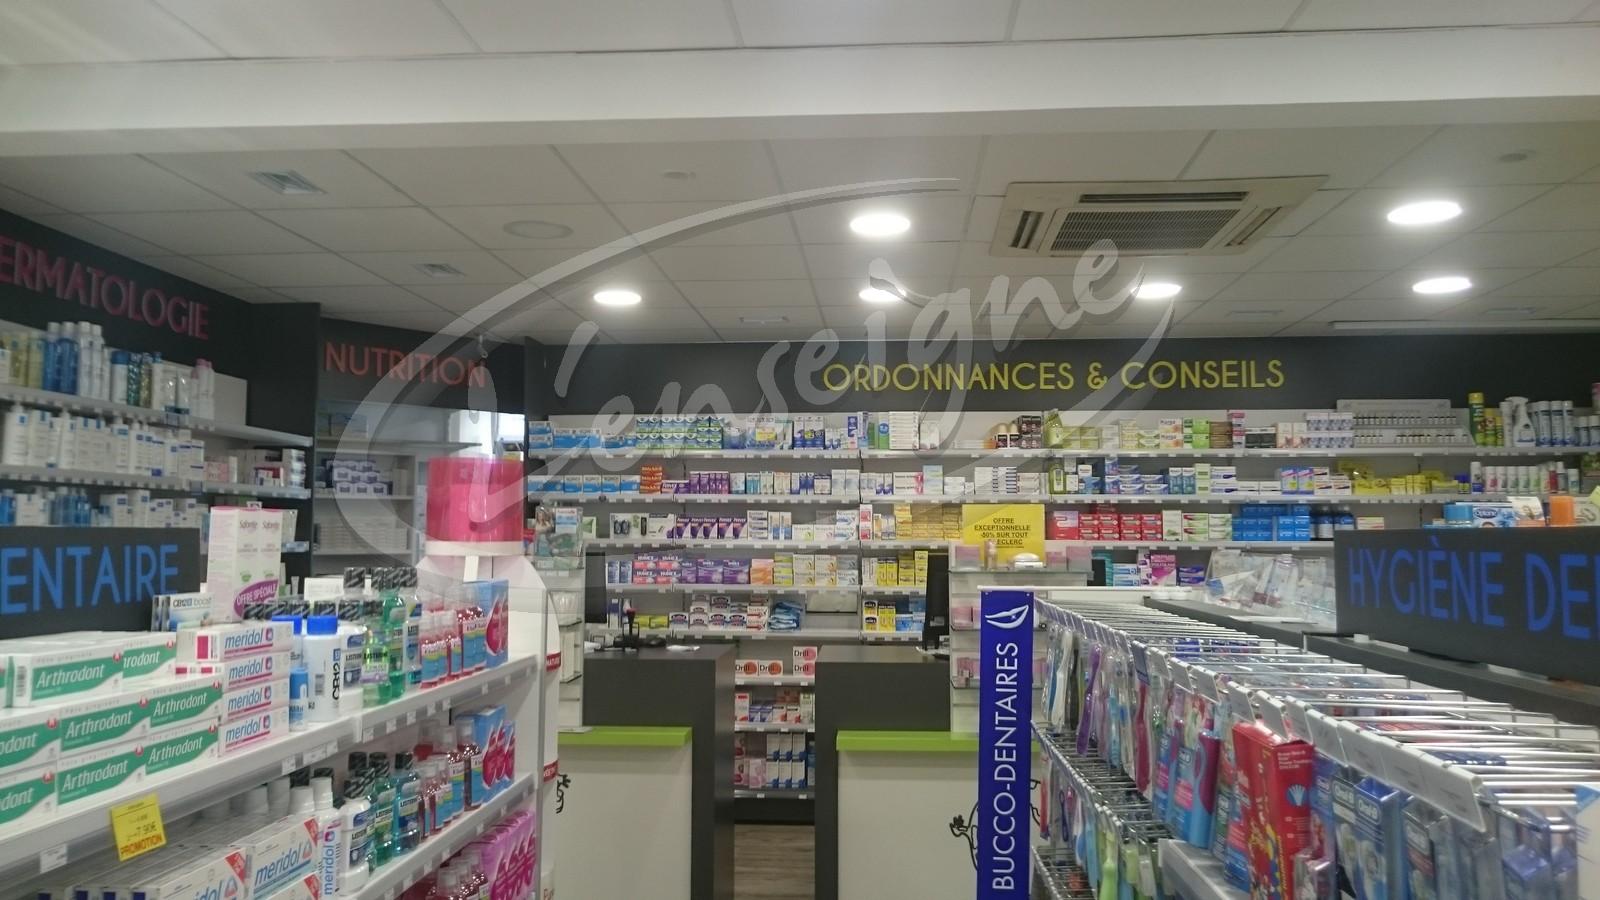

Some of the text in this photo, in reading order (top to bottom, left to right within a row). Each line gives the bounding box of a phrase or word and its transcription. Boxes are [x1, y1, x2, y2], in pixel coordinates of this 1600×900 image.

[325, 342, 486, 388] NUTRITION
[823, 360, 1284, 391] ORDONNANCES & CONSEILS
[1, 544, 178, 615] ENTAIRE
[1347, 535, 1600, 645] HYGIÈNE DE
[225, 627, 263, 650] meridol
[36, 664, 106, 689] Arthrodont
[229, 661, 263, 680] meridol
[153, 692, 207, 717] Arthrodont
[227, 690, 262, 711] meridol
[65, 711, 133, 739] Arthrodont
[226, 720, 261, 743] meridol
[148, 735, 203, 763] Arthrodont
[62, 760, 128, 792] Arthrodont
[992, 641, 1019, 890] BUCCO-DENTAIRES
[254, 842, 302, 888] meridol
[323, 845, 337, 895] meridol
